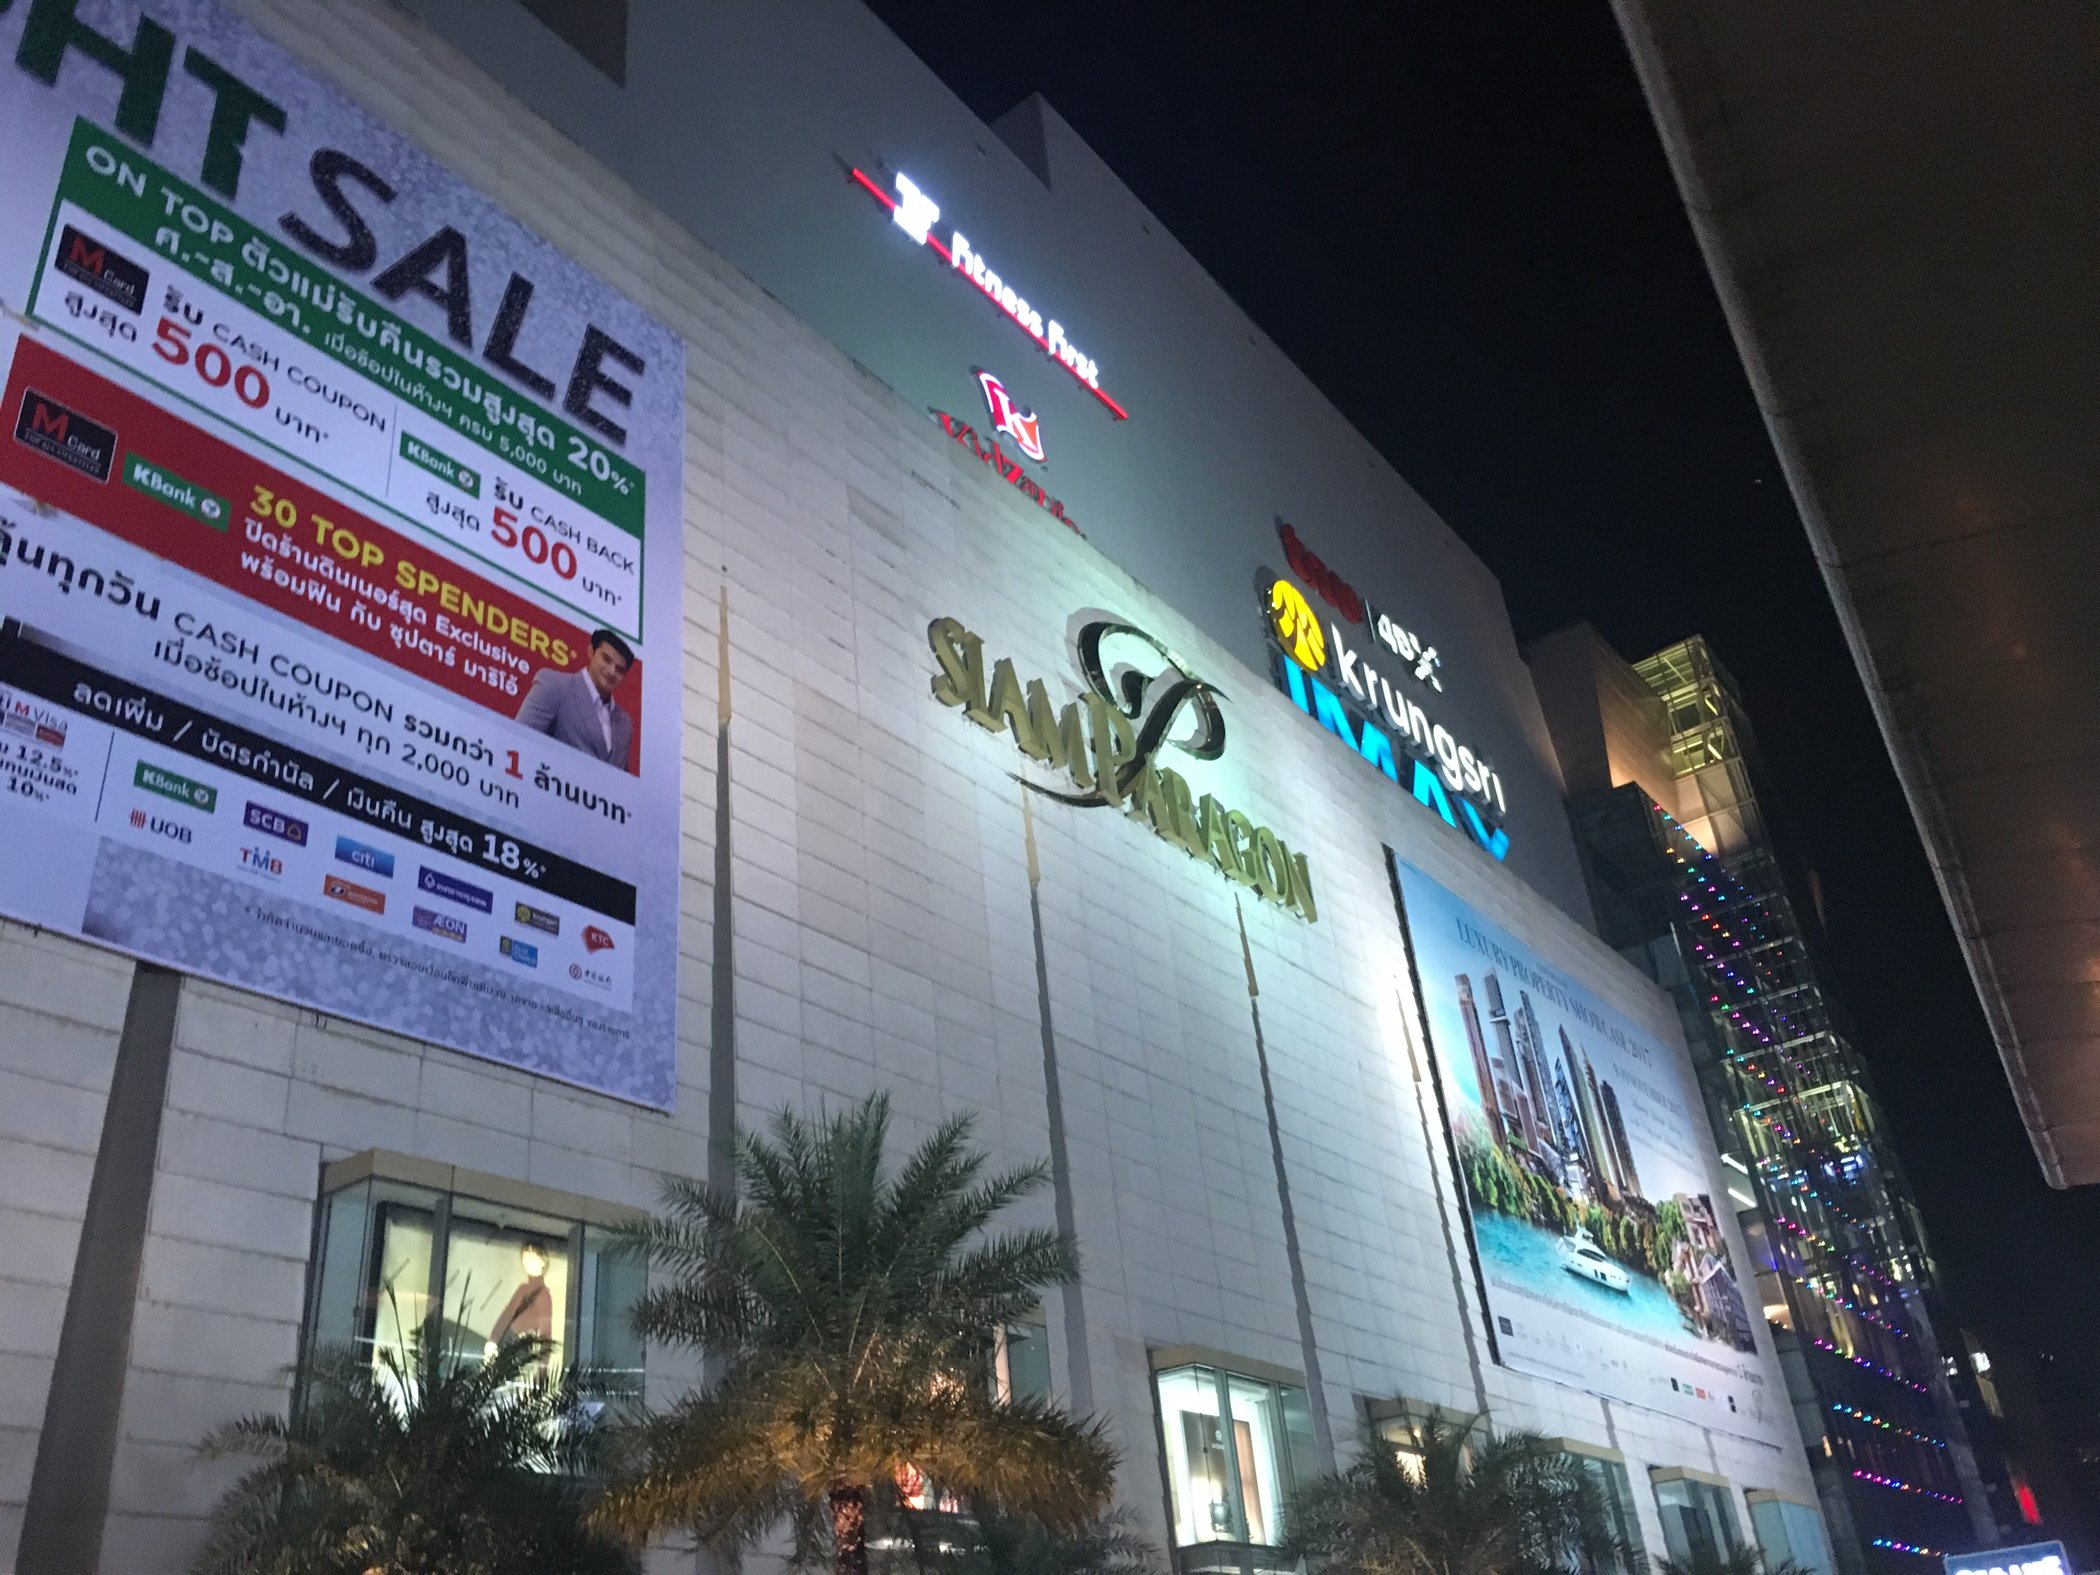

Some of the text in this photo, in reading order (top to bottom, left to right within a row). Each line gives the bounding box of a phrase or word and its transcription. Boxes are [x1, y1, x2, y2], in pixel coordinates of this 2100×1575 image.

[0, 0, 646, 447] HT SALE
[68, 235, 106, 276] M
[85, 146, 147, 198] ON
[160, 186, 234, 245] TOP
[241, 236, 557, 450] ตัวแม่รับคืนรวมสูงสุด
[64, 290, 138, 343] สูงสุด
[151, 316, 271, 410] 500
[164, 283, 204, 326] รับ
[212, 322, 280, 372] CASH
[287, 365, 386, 432] COUPON
[32, 402, 101, 461] M Card
[407, 441, 456, 478] KBank
[459, 411, 493, 443] ครบ
[499, 433, 548, 475] 5,000
[552, 466, 583, 497] บาท
[132, 462, 196, 510] KBank
[250, 484, 298, 529] 30
[310, 513, 385, 568] TOP
[494, 475, 635, 575] รับ CASH BACK
[426, 491, 481, 532] สูงสุด
[490, 505, 578, 580] 500
[240, 550, 519, 697] พร้อมฟิน กับ ซุปตาร์ มาริโอ้
[244, 516, 531, 675] ปิดร้านดินเนอร์สุด Exclusive
[153, 637, 520, 810] เมื่อช้อปในห้างฯ ทุก 2,000 บาท
[173, 611, 259, 665] CASH
[269, 653, 394, 724] COUPON
[403, 711, 495, 767] รวมกว่า
[504, 749, 524, 781] 1
[73, 682, 165, 732] ลดเพิ่ม
[201, 727, 315, 792] บัตรกำนัล
[346, 784, 412, 830] เงินคืน
[420, 817, 474, 856] สูงสุด
[142, 768, 191, 799] KBank
[927, 616, 1319, 925] SIAM PARAGON
[150, 815, 193, 844] UOB
[240, 846, 283, 876] TMB
[249, 808, 286, 834] SCB
[352, 850, 376, 869] citi
[590, 931, 609, 946] KTC
[1456, 917, 1509, 972] LUXURY
[1509, 954, 1570, 1012] PROPERTY
